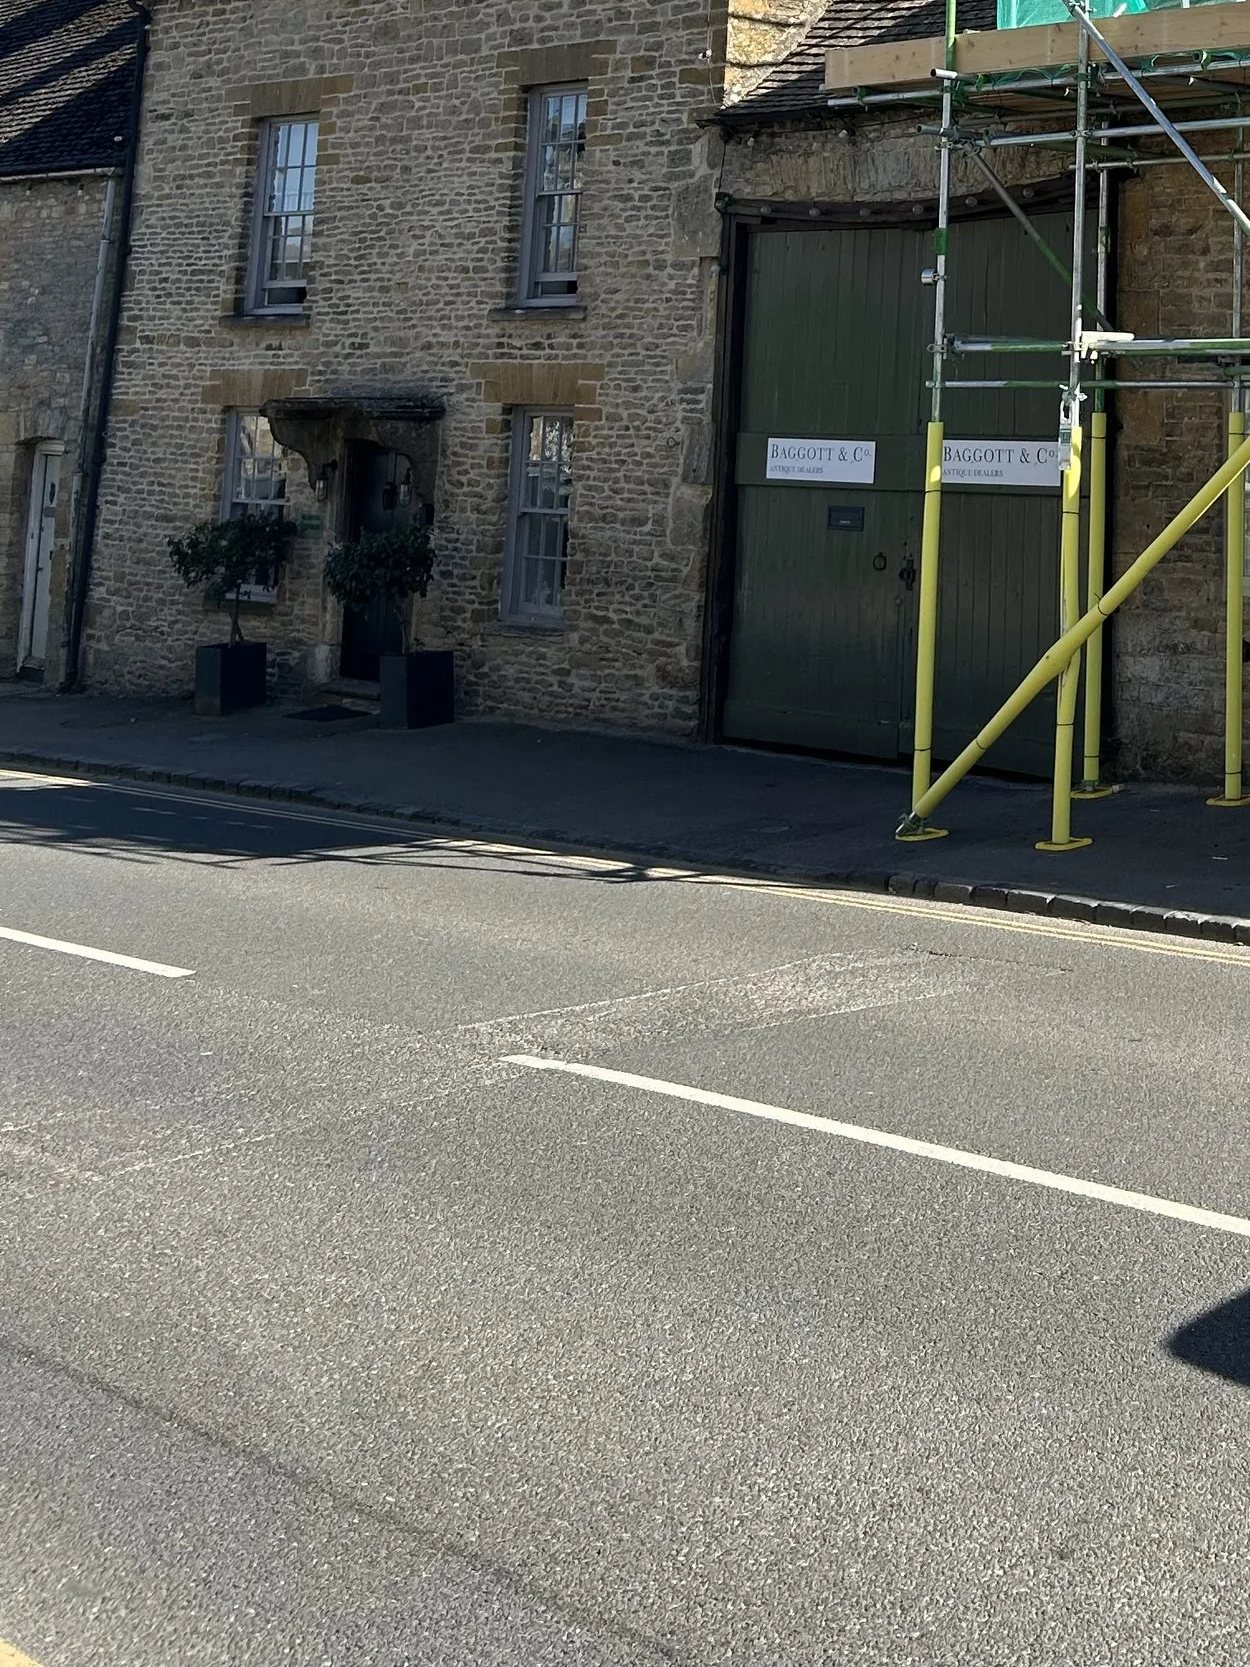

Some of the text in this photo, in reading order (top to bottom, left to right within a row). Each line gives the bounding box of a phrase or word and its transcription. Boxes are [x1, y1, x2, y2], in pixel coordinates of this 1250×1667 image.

[838, 446, 848, 462] &
[1020, 447, 1030, 463] &
[769, 465, 824, 474] ANTIQUE DEALERS
[943, 468, 1004, 478] ANTIQUE DEALERS
